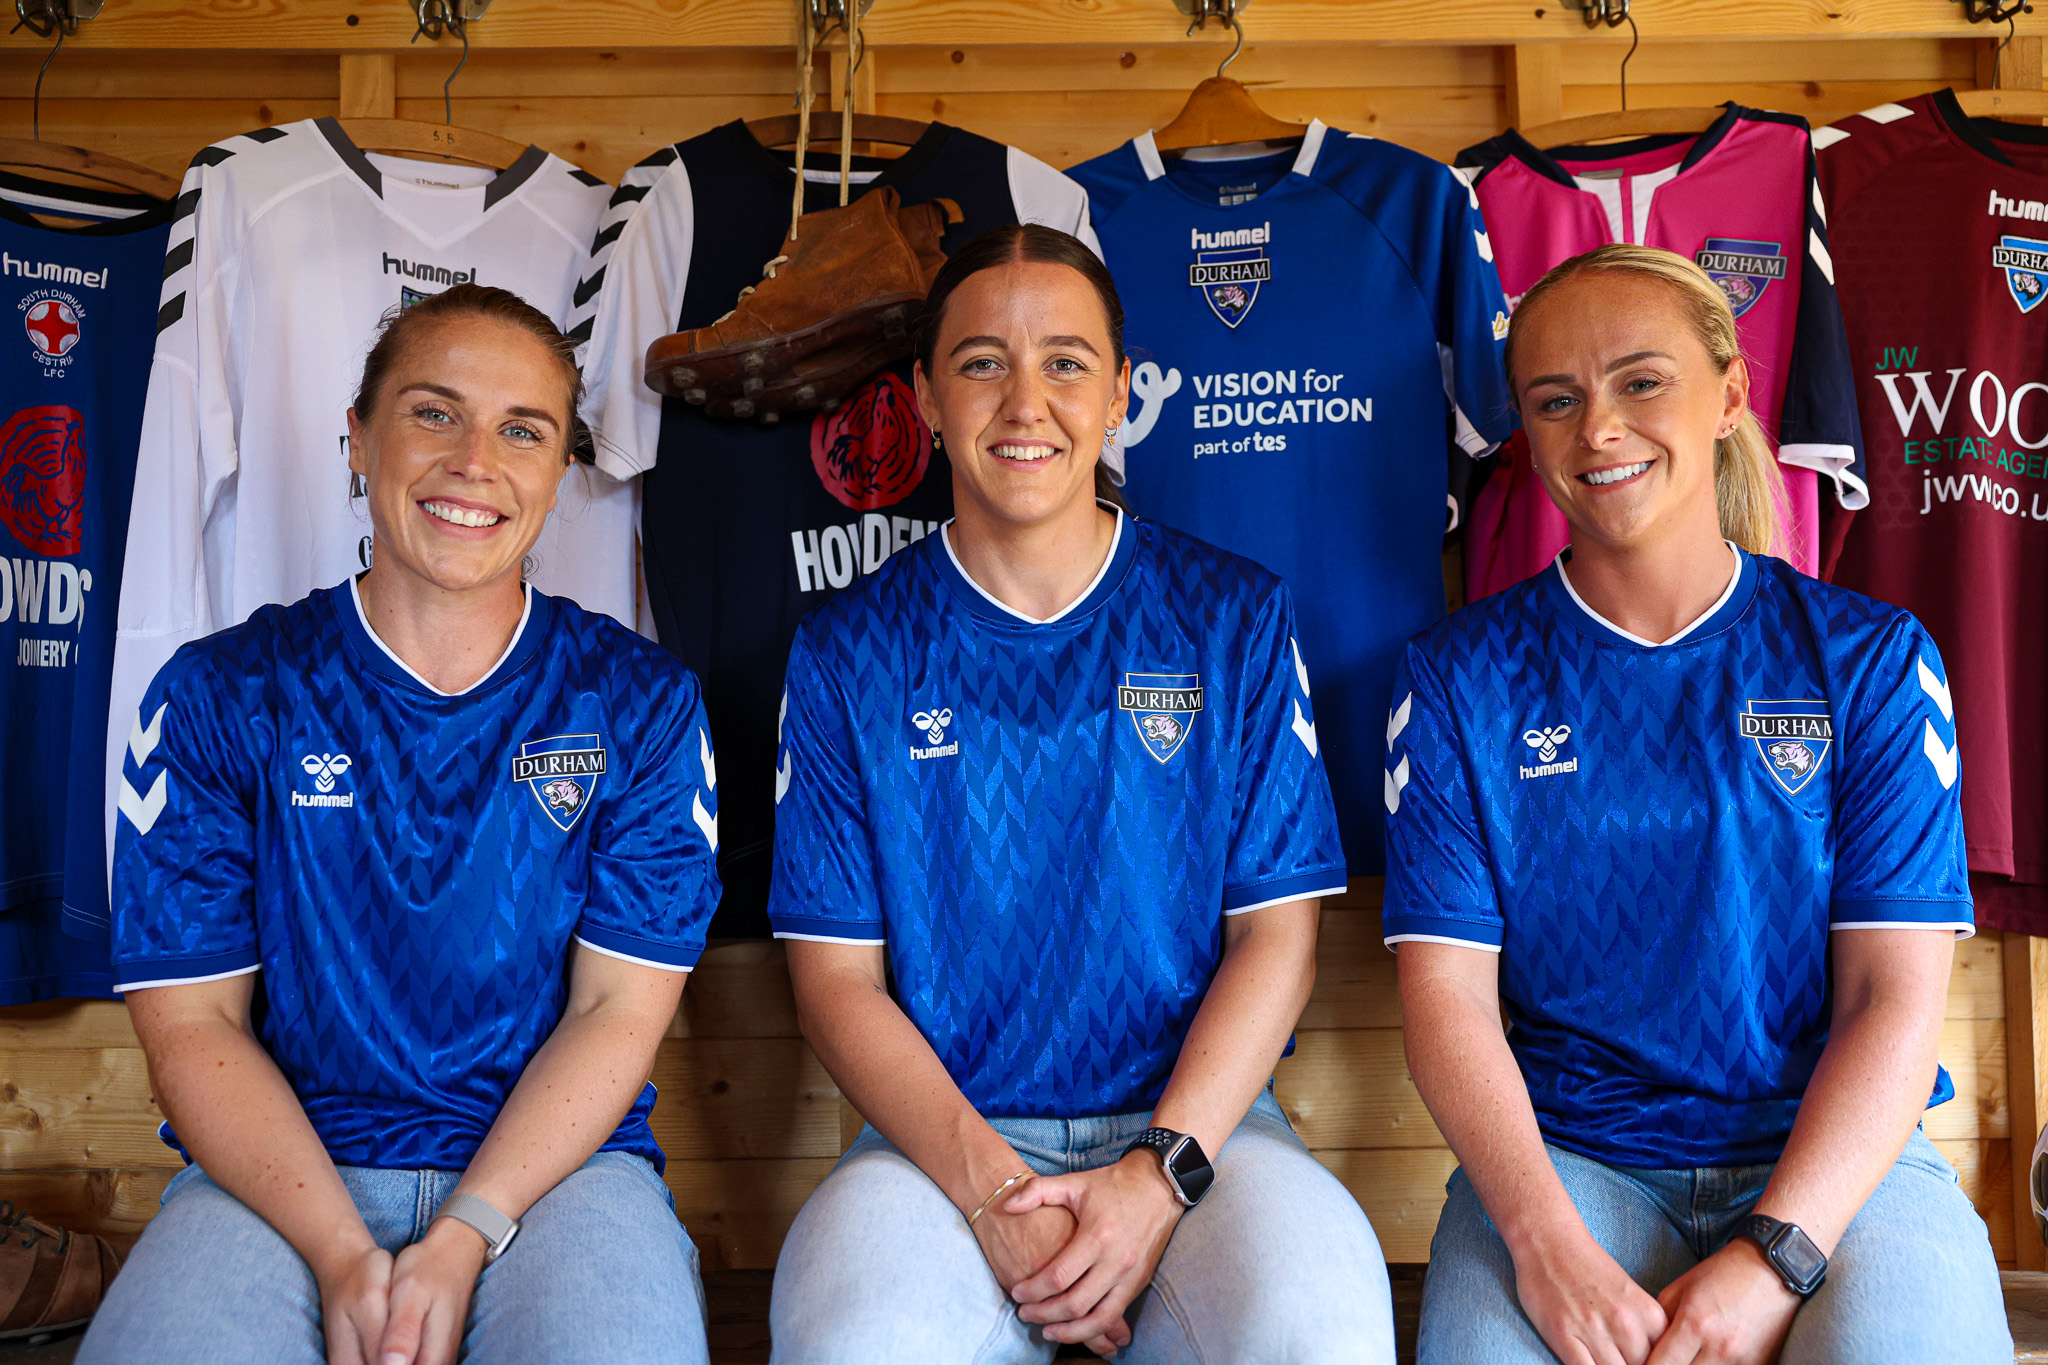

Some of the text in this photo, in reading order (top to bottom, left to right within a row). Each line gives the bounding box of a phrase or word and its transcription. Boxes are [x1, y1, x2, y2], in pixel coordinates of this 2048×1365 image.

[1191, 221, 1270, 250] hummel
[3, 252, 108, 289] hummel
[382, 252, 476, 287] hummel
[1195, 262, 1267, 283] DURHAM
[1700, 253, 1780, 275] DURHAM
[17, 288, 87, 319] SOUTH DURHAM
[1876, 346, 1918, 370] JW
[43, 368, 65, 379] LFC
[1192, 368, 1344, 399] VISION for
[1193, 397, 1373, 429] EDUCATION
[1193, 431, 1287, 459] part of tes
[17, 638, 71, 668] JOINERY
[1123, 690, 1201, 709] DURHAM
[1745, 717, 1834, 738] DURHAM
[909, 741, 959, 761] hummel
[518, 755, 605, 778] DURHAM
[1519, 757, 1578, 781] hummel
[291, 790, 354, 808] hummel
